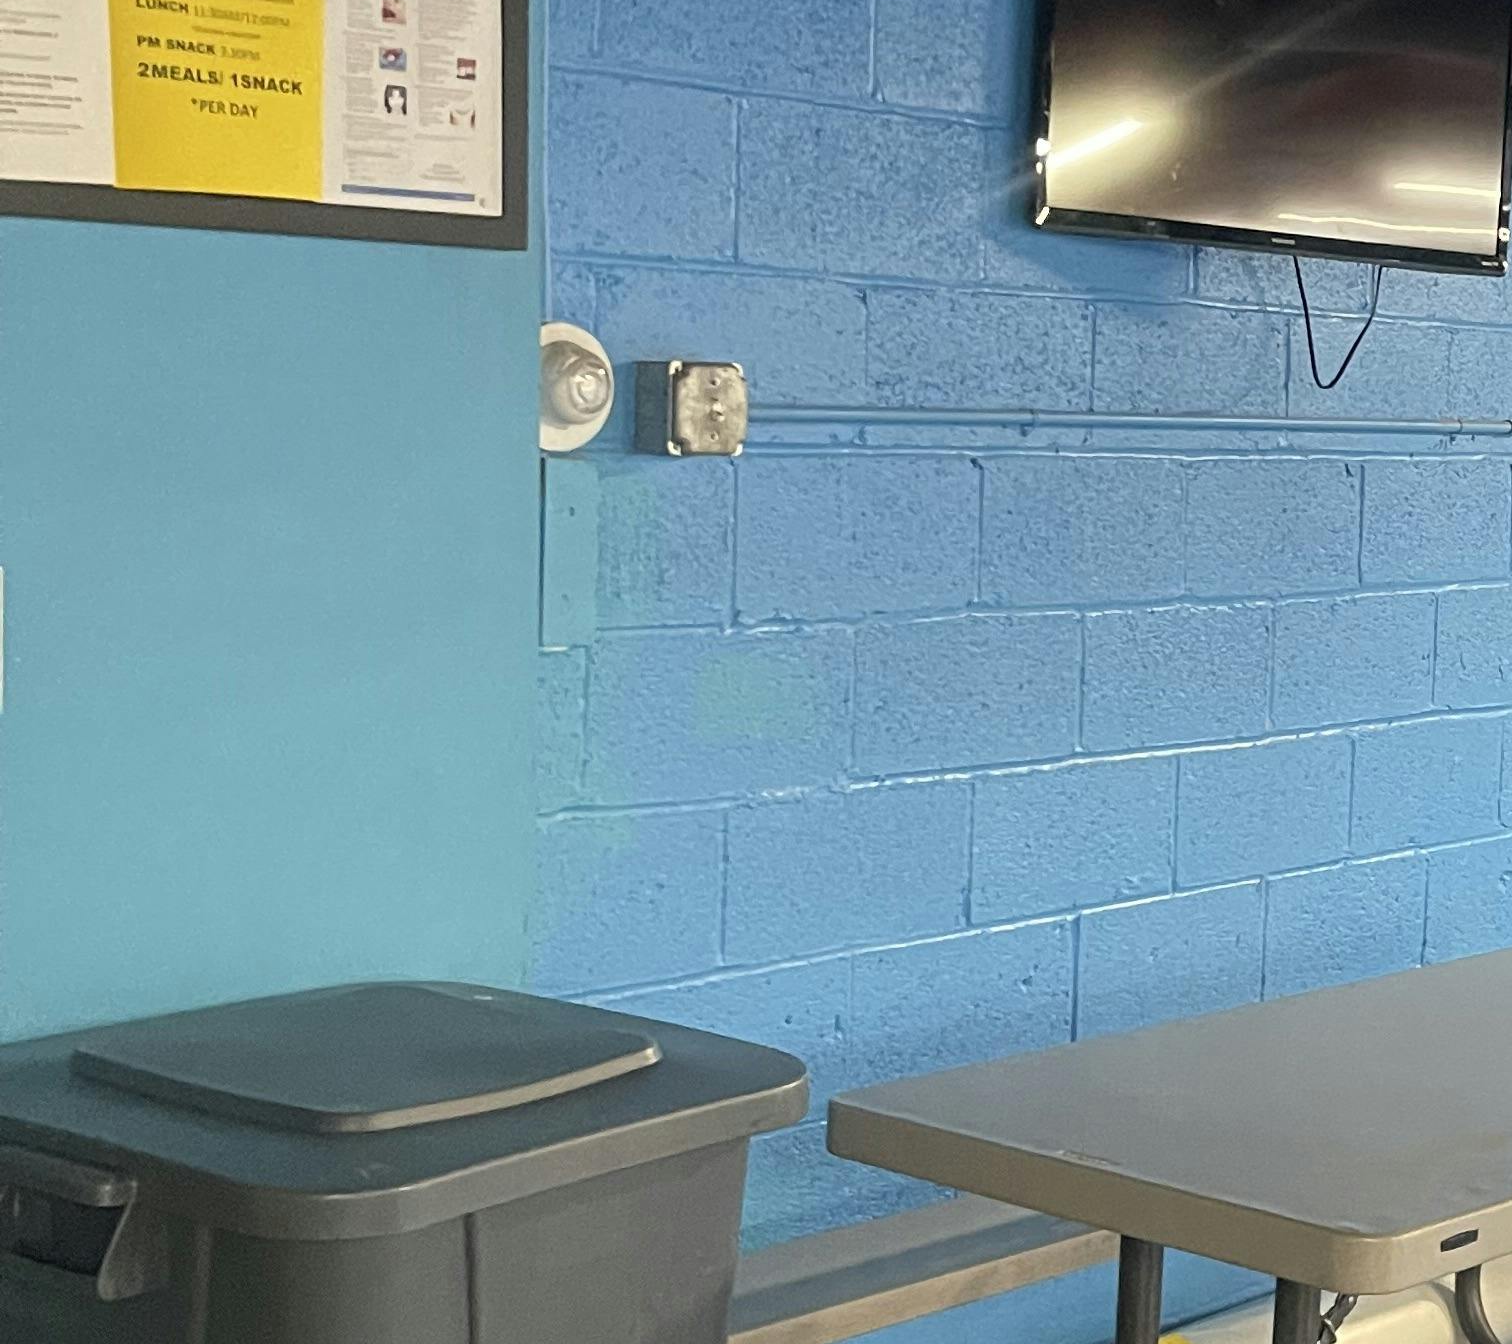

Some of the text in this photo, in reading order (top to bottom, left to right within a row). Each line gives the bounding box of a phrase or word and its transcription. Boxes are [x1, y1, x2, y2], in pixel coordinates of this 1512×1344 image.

[136, 34, 162, 49] PM
[166, 38, 216, 56] SNACK
[230, 72, 304, 96] 1SNACK
[229, 103, 260, 120] DAY
